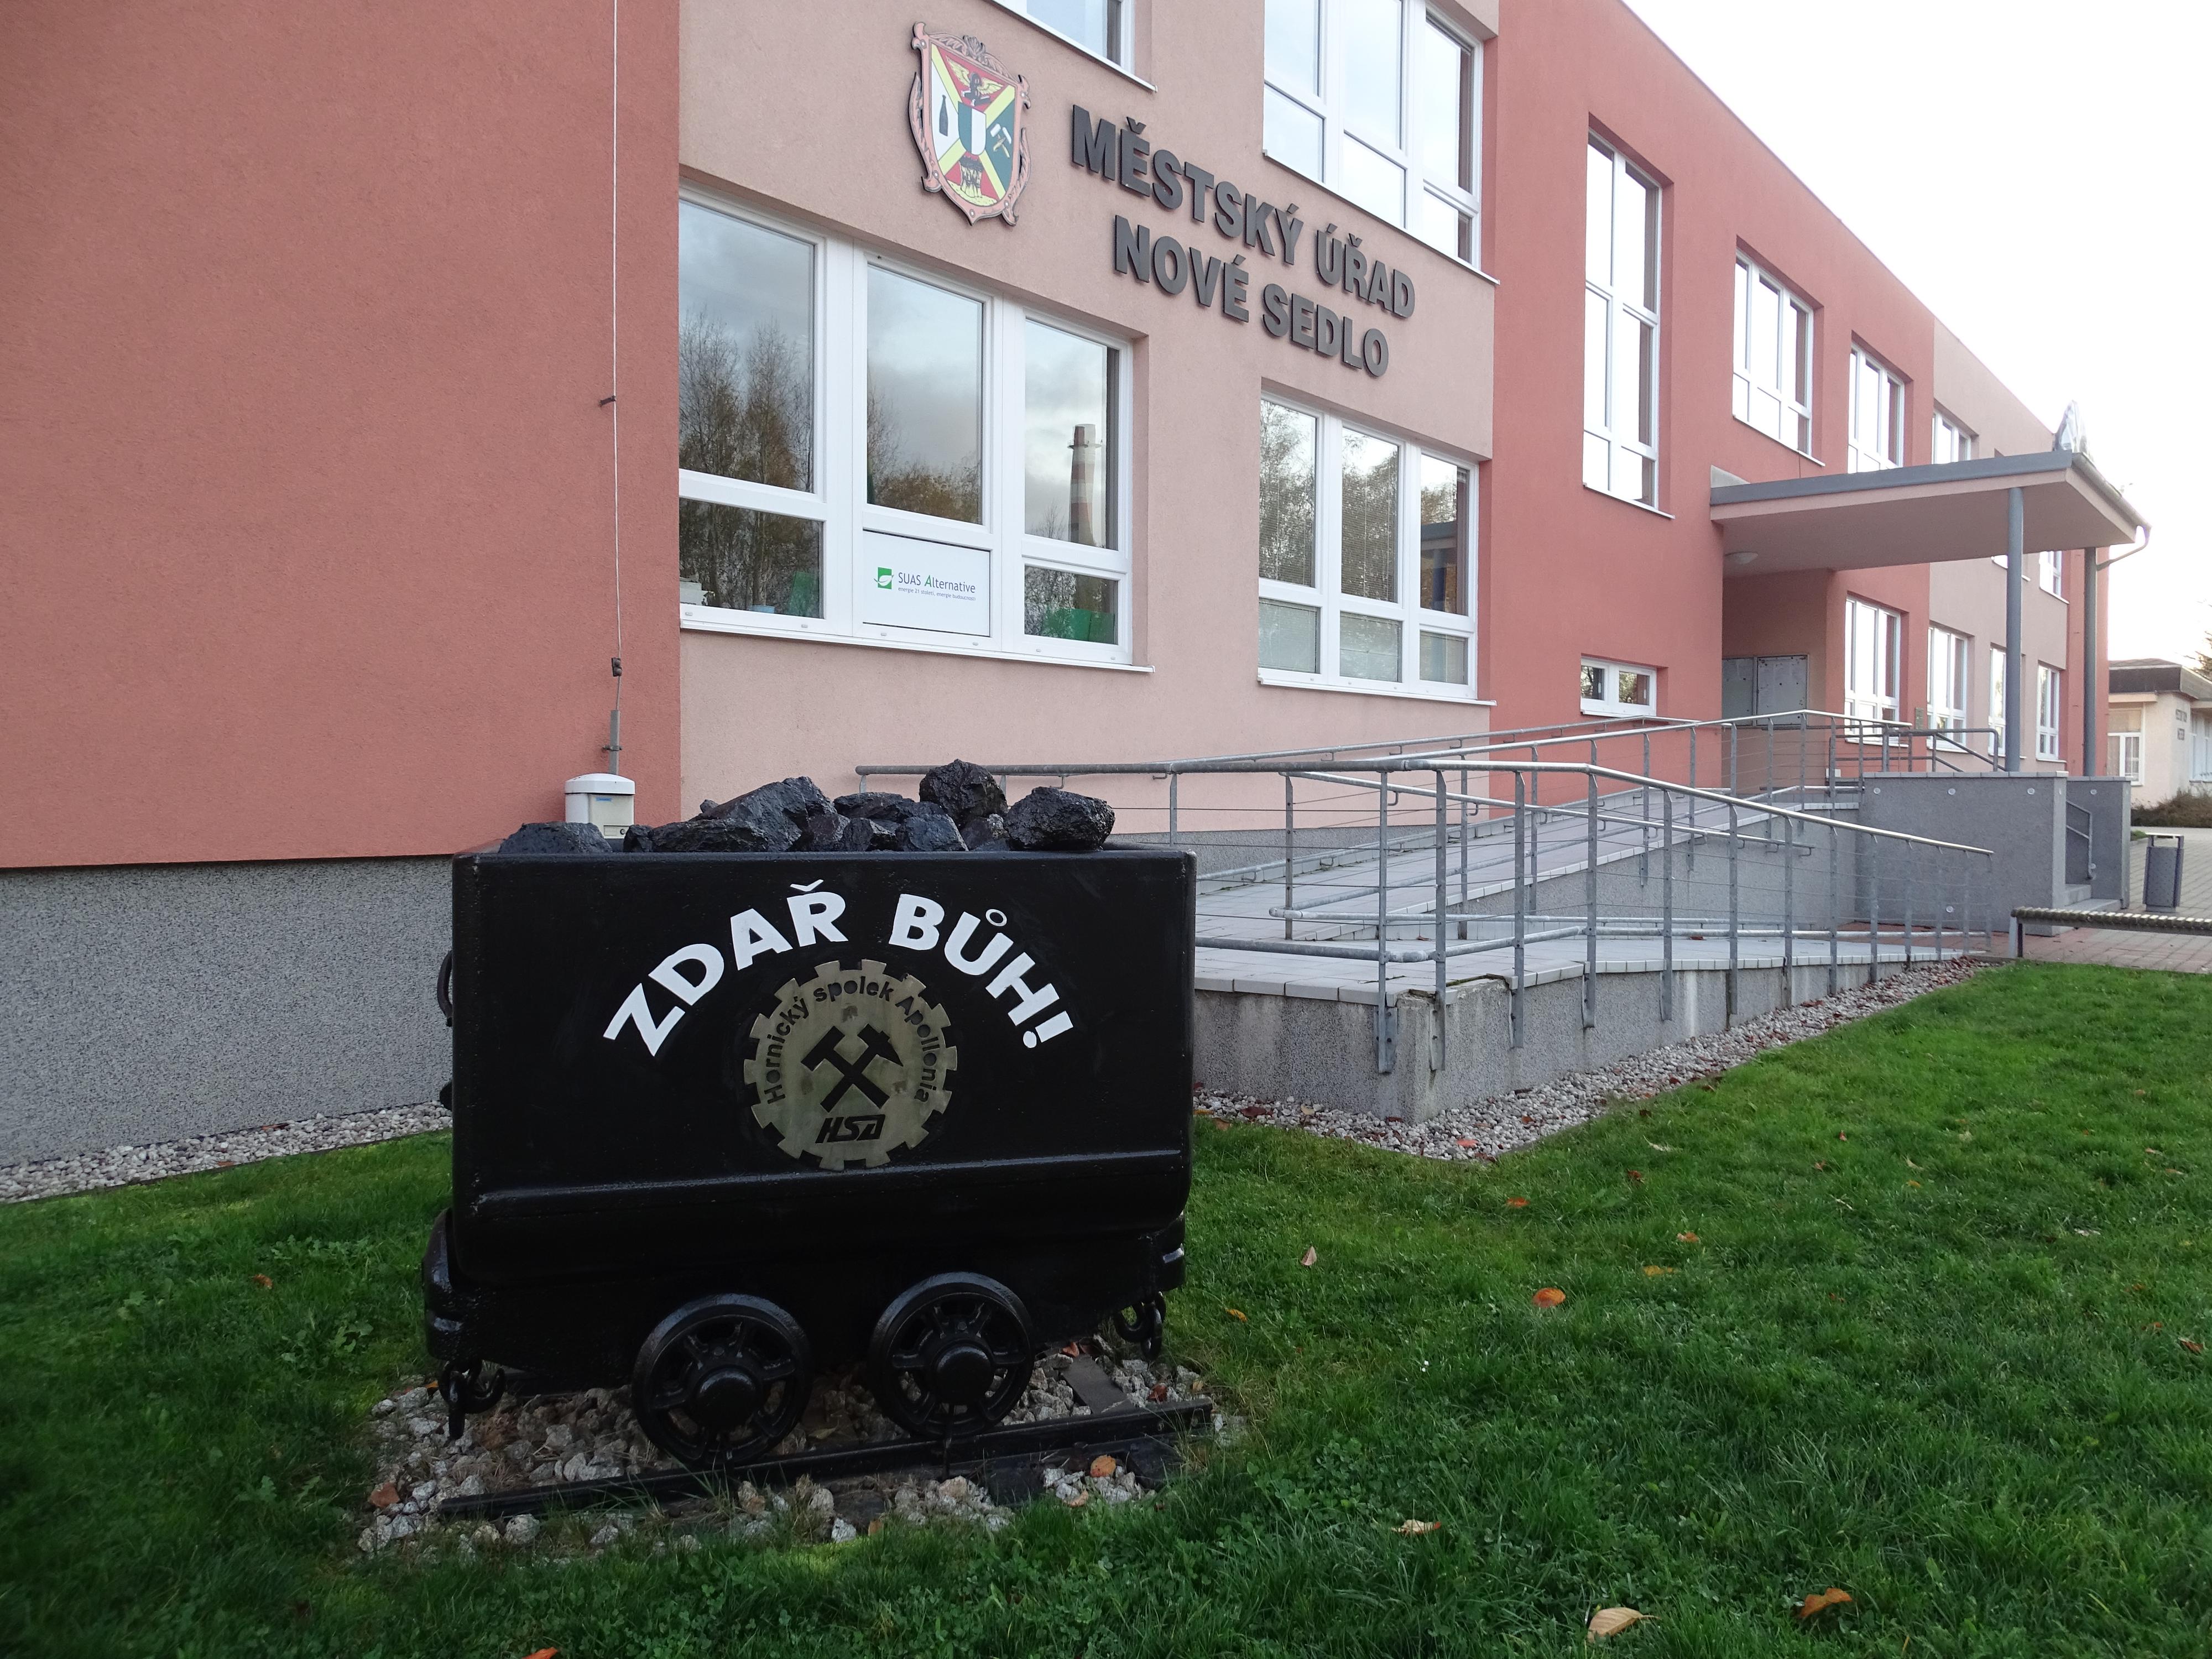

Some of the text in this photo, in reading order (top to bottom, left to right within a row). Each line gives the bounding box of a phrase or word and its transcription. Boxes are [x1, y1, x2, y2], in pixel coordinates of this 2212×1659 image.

[1072, 105, 1415, 319] MĚSTSKÝ ÚŘAD
[1114, 215, 1389, 378] NOVÉ SEDLO
[898, 572, 975, 593] SUAS Alternative
[603, 879, 1073, 1057] ZDAŘ BŮH!
[764, 975, 940, 1104] Hornický spolek Apollonia
